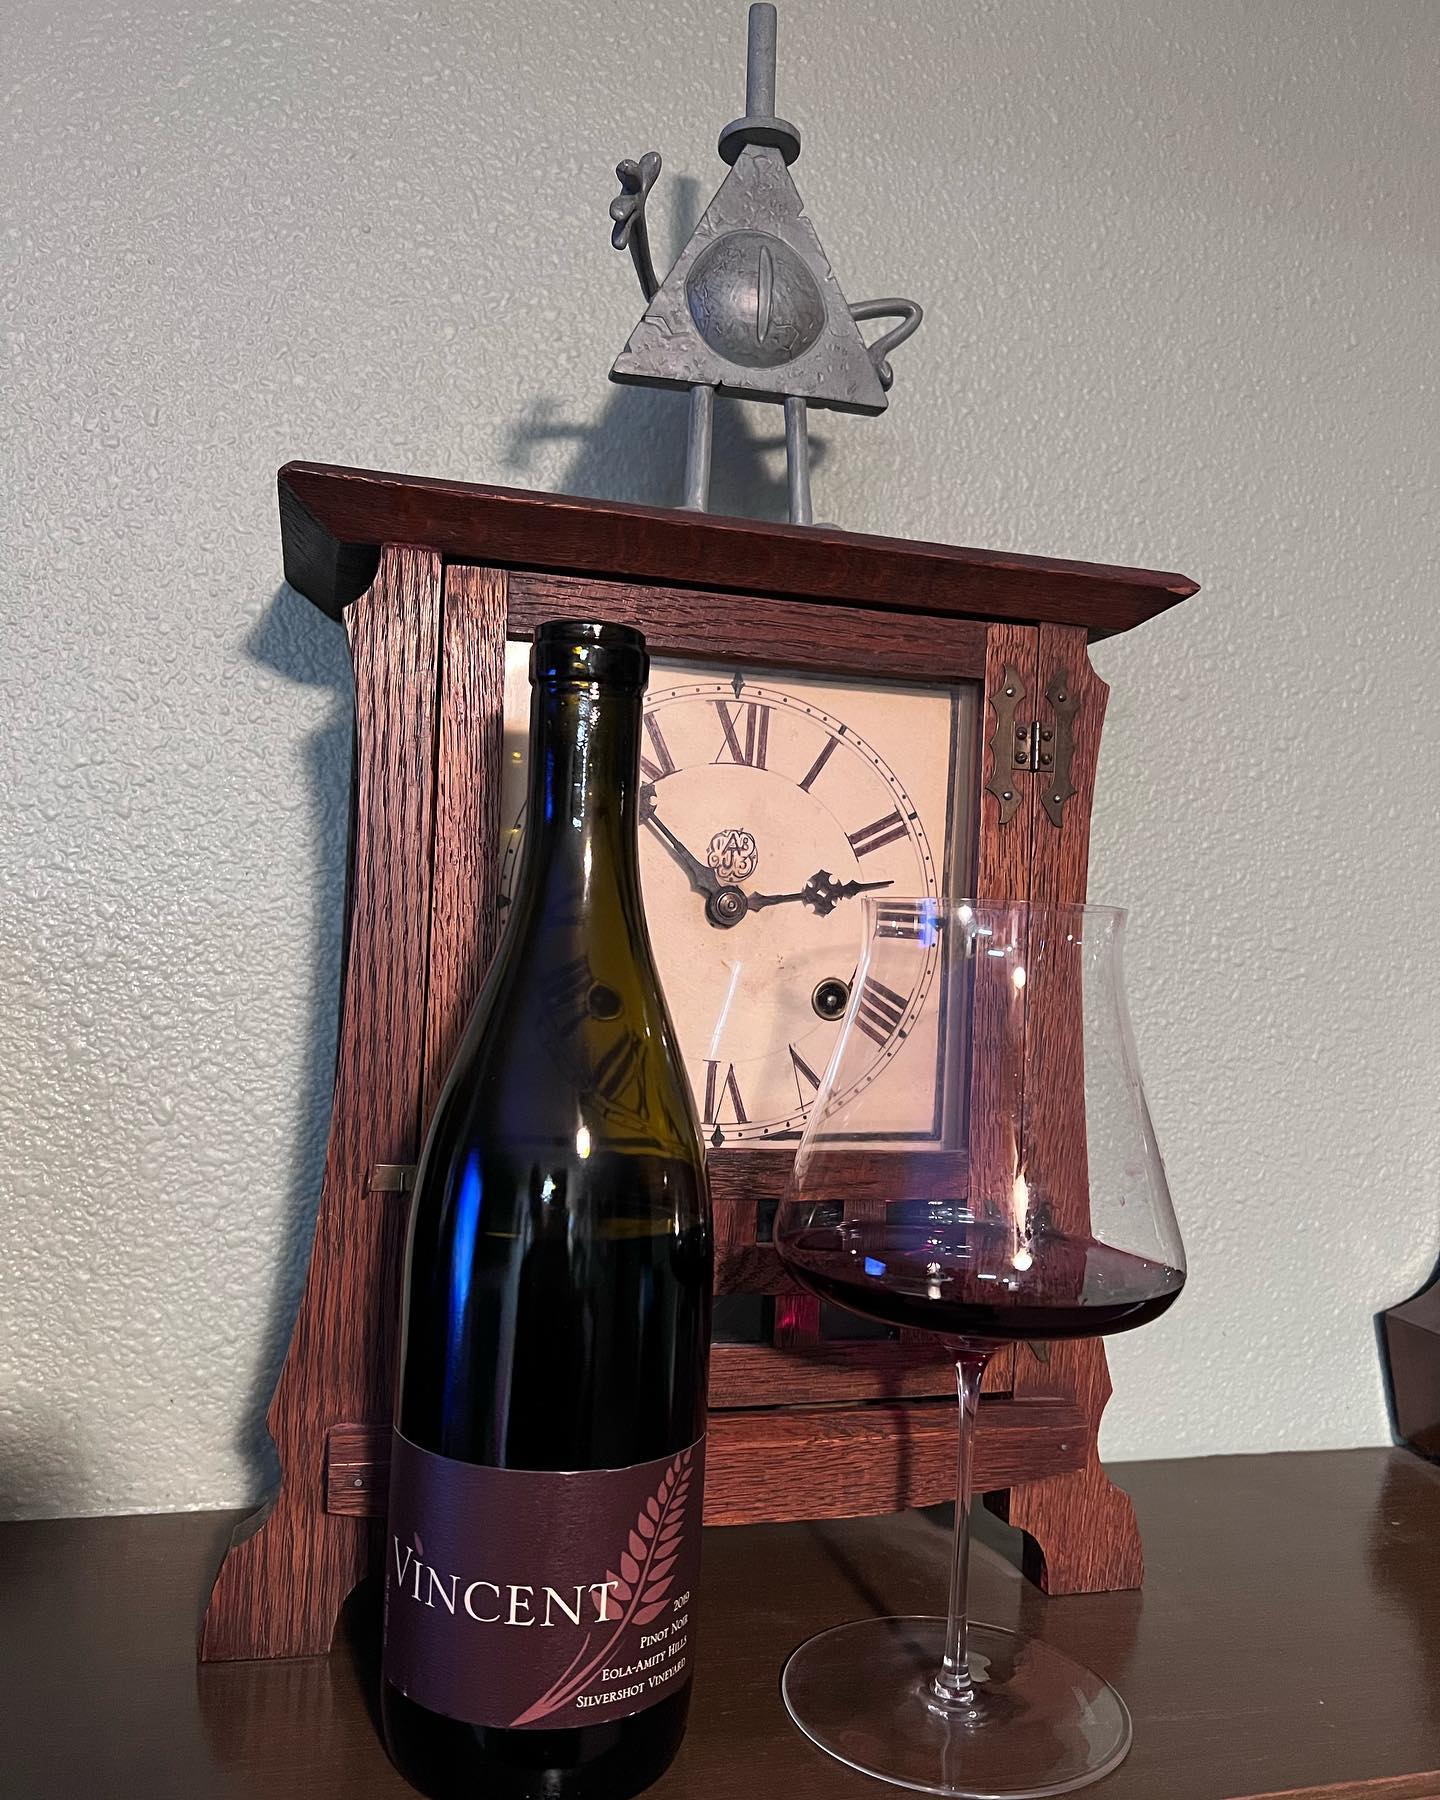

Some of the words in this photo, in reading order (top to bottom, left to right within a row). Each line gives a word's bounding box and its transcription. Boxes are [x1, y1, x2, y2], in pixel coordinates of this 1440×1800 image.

[705, 699, 777, 772] XII
[843, 804, 911, 863] II
[392, 1534, 619, 1627] VINCENT
[673, 1591, 690, 1612] 2019
[640, 1627, 669, 1649] PINOT
[671, 1614, 689, 1635] NOIR
[576, 1682, 645, 1708] SILVERSHOT
[648, 1657, 686, 1688] VINEYARD
[601, 1650, 666, 1681] EOLA-AMITY
[668, 1635, 688, 1657] HILLS
